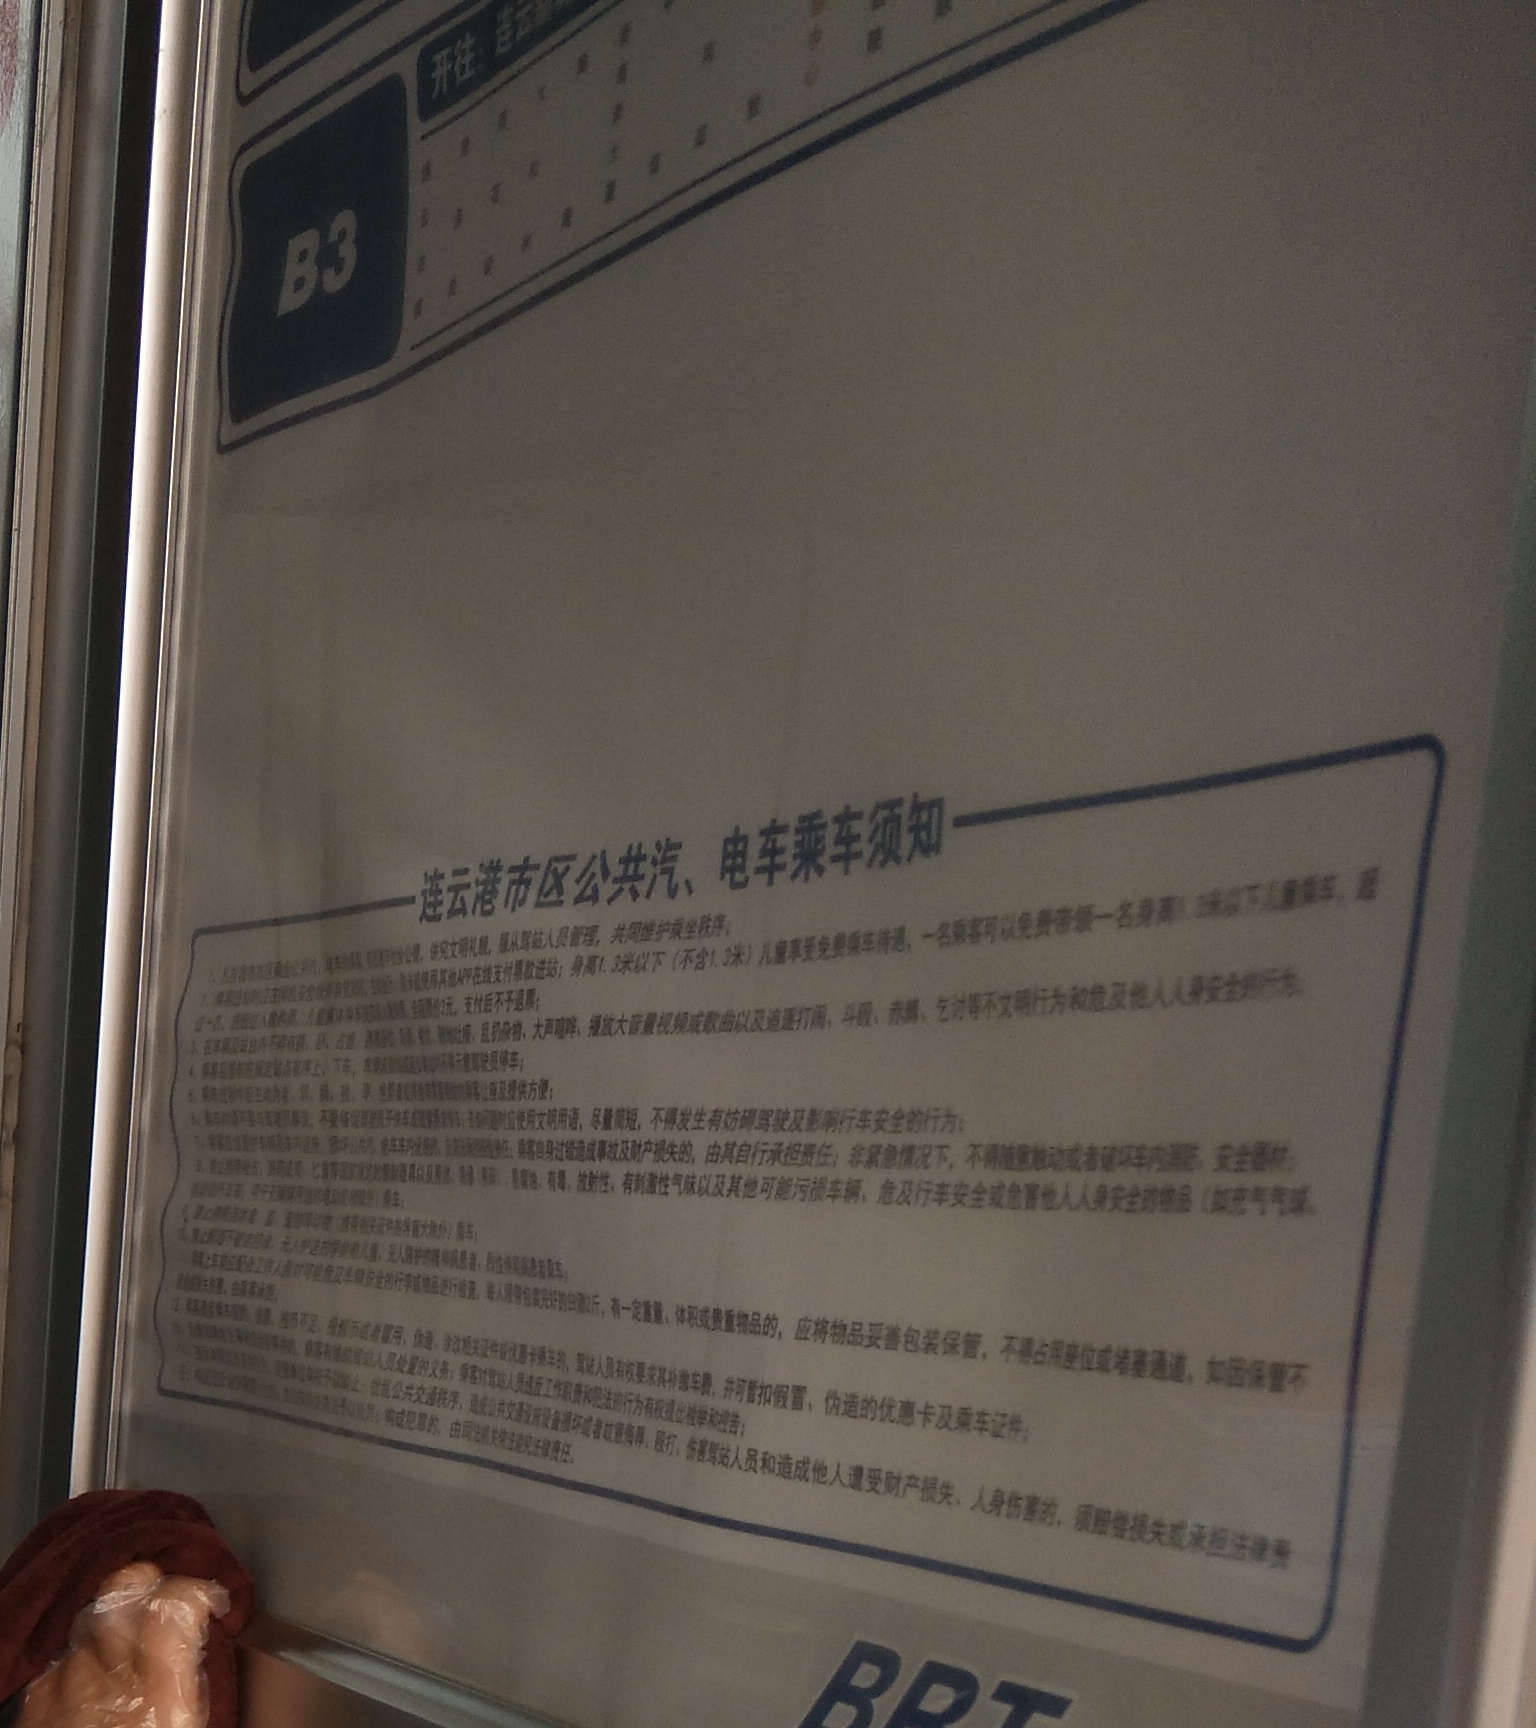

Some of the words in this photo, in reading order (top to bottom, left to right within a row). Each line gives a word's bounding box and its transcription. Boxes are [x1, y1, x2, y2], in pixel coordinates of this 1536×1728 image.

[277, 209, 358, 317] B3
[417, 790, 945, 924] 连云港市区公共汽、电车乘车须知
